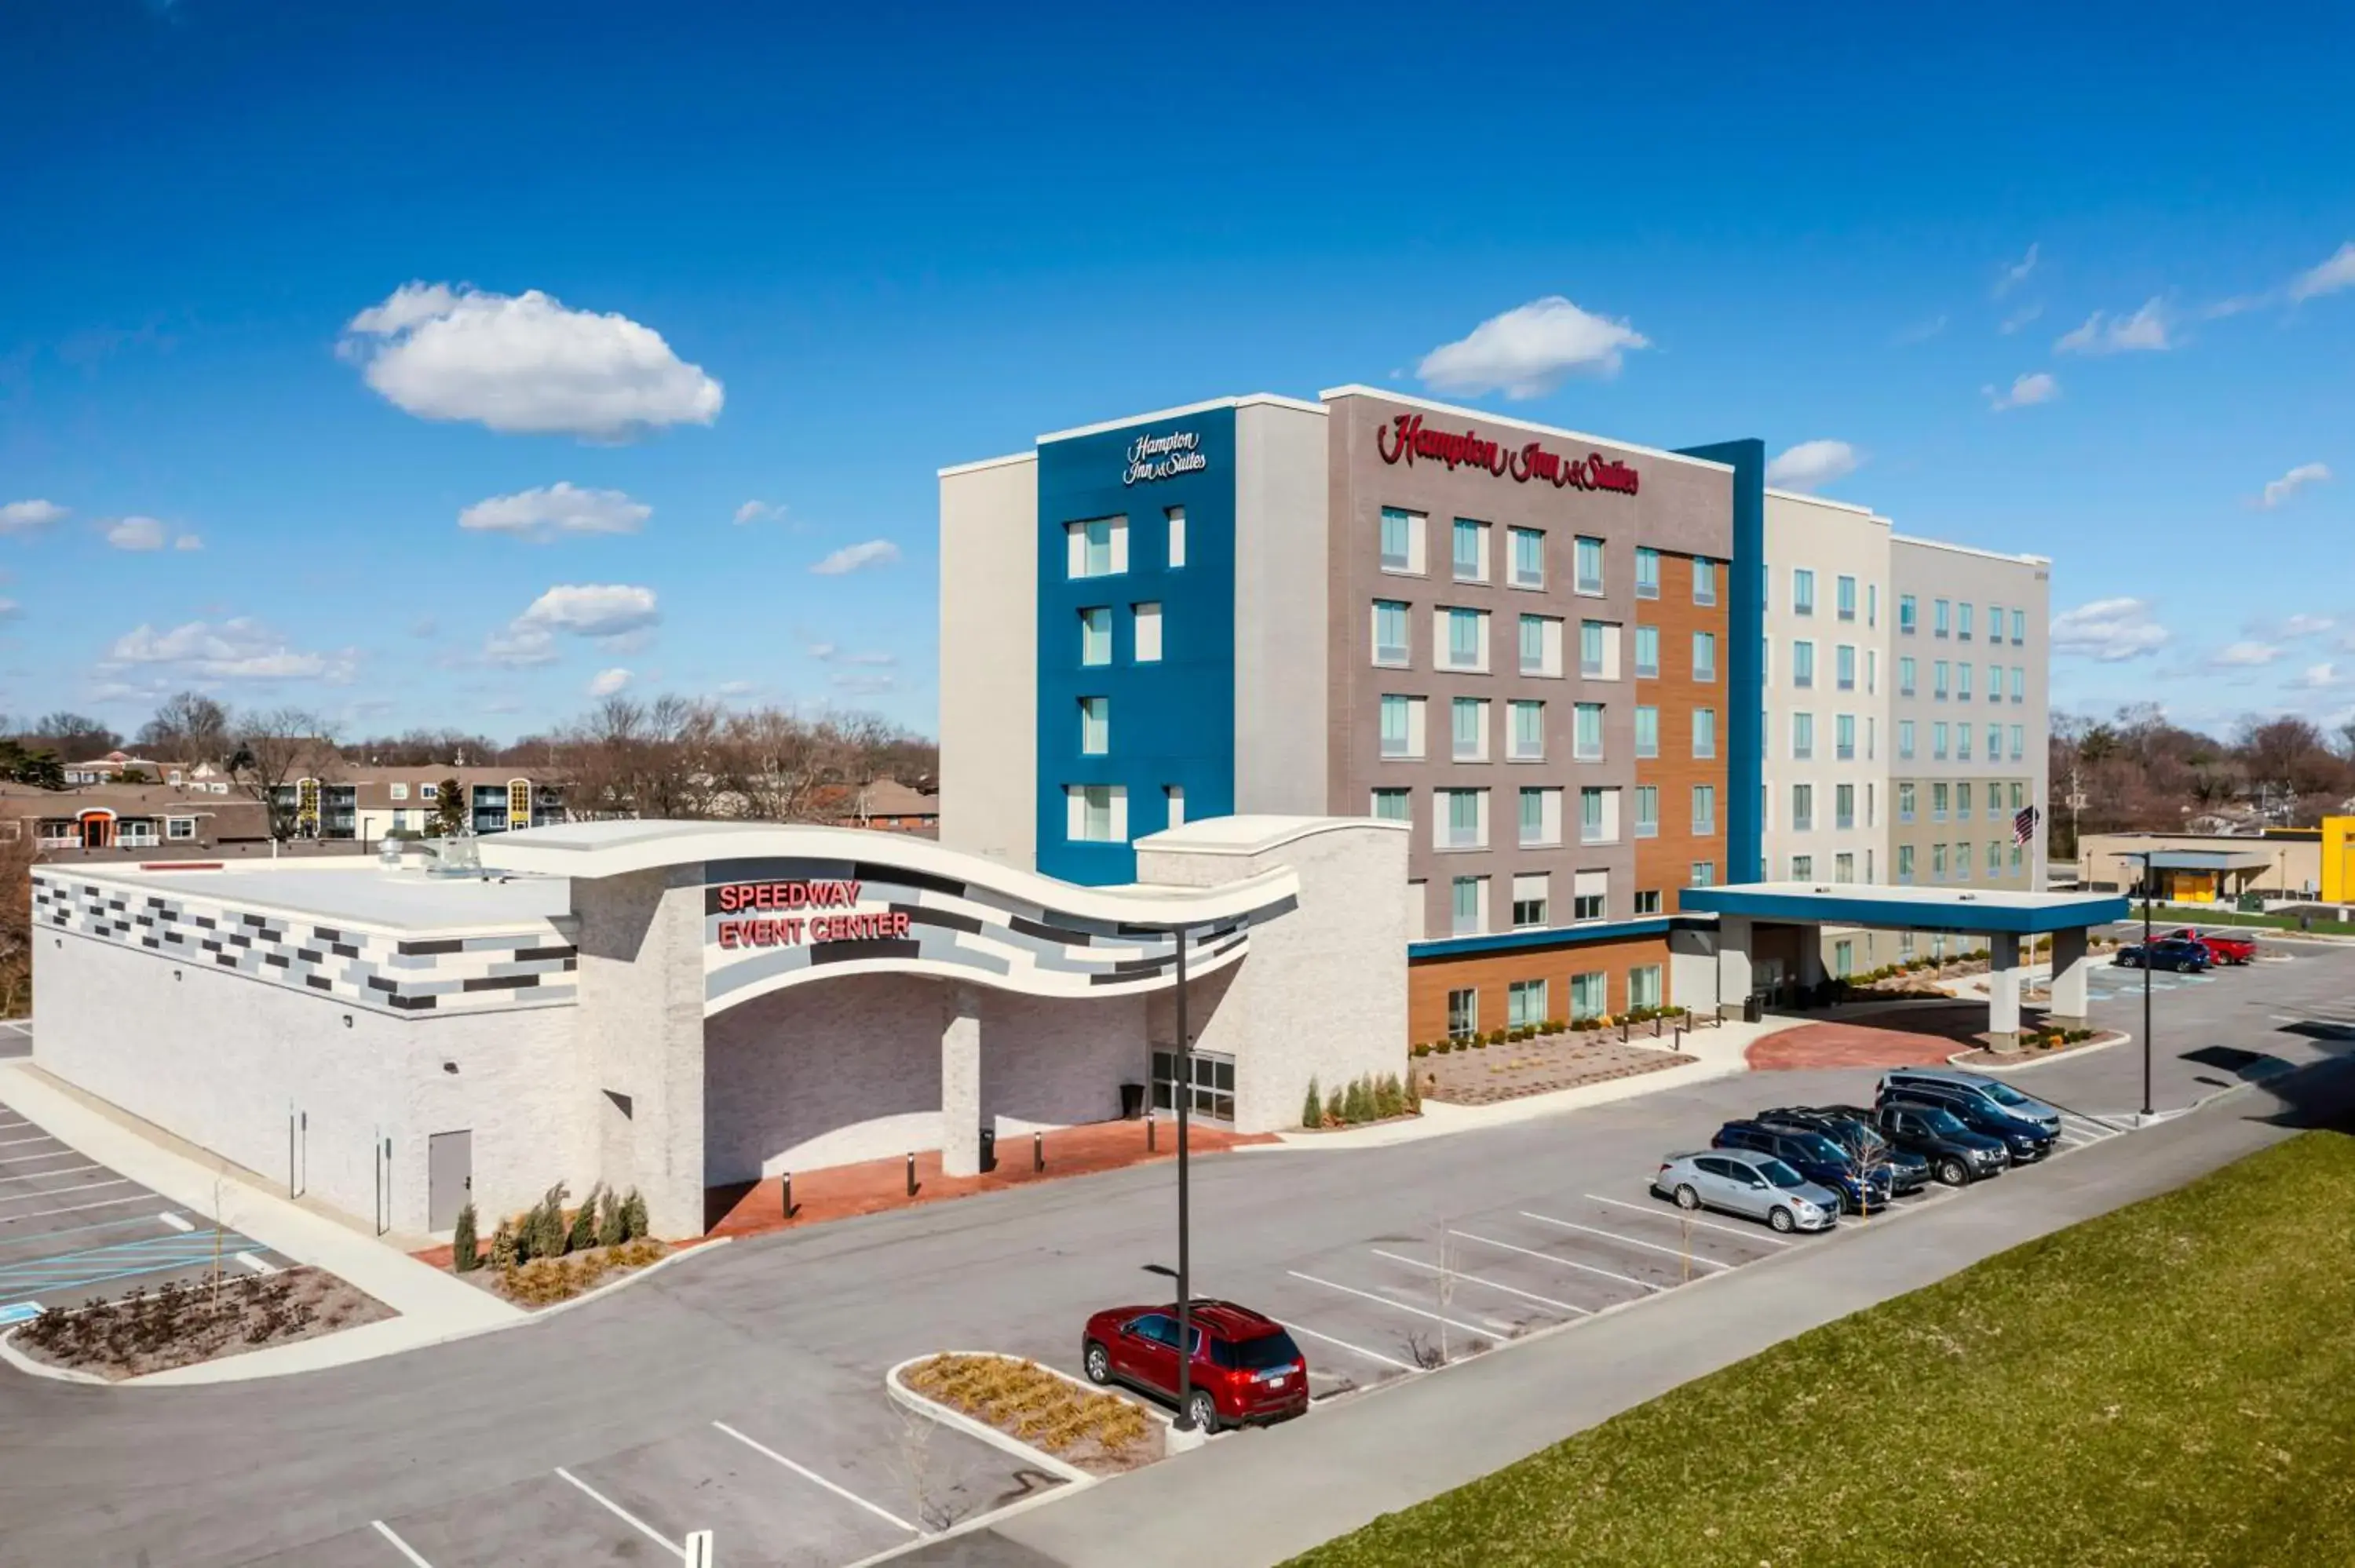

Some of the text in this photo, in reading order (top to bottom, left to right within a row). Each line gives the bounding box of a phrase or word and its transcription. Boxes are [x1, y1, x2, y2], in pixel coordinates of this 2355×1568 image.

[1127, 431, 1199, 464] Hampton
[1378, 414, 1508, 477] Hampton
[1509, 443, 1569, 488] Inn
[1580, 451, 1639, 496] Suites
[1123, 460, 1156, 484] Inn
[1166, 451, 1206, 475] Suites
[720, 880, 861, 911] SPEEDWAY
[718, 911, 911, 950] EVENT CENTER
